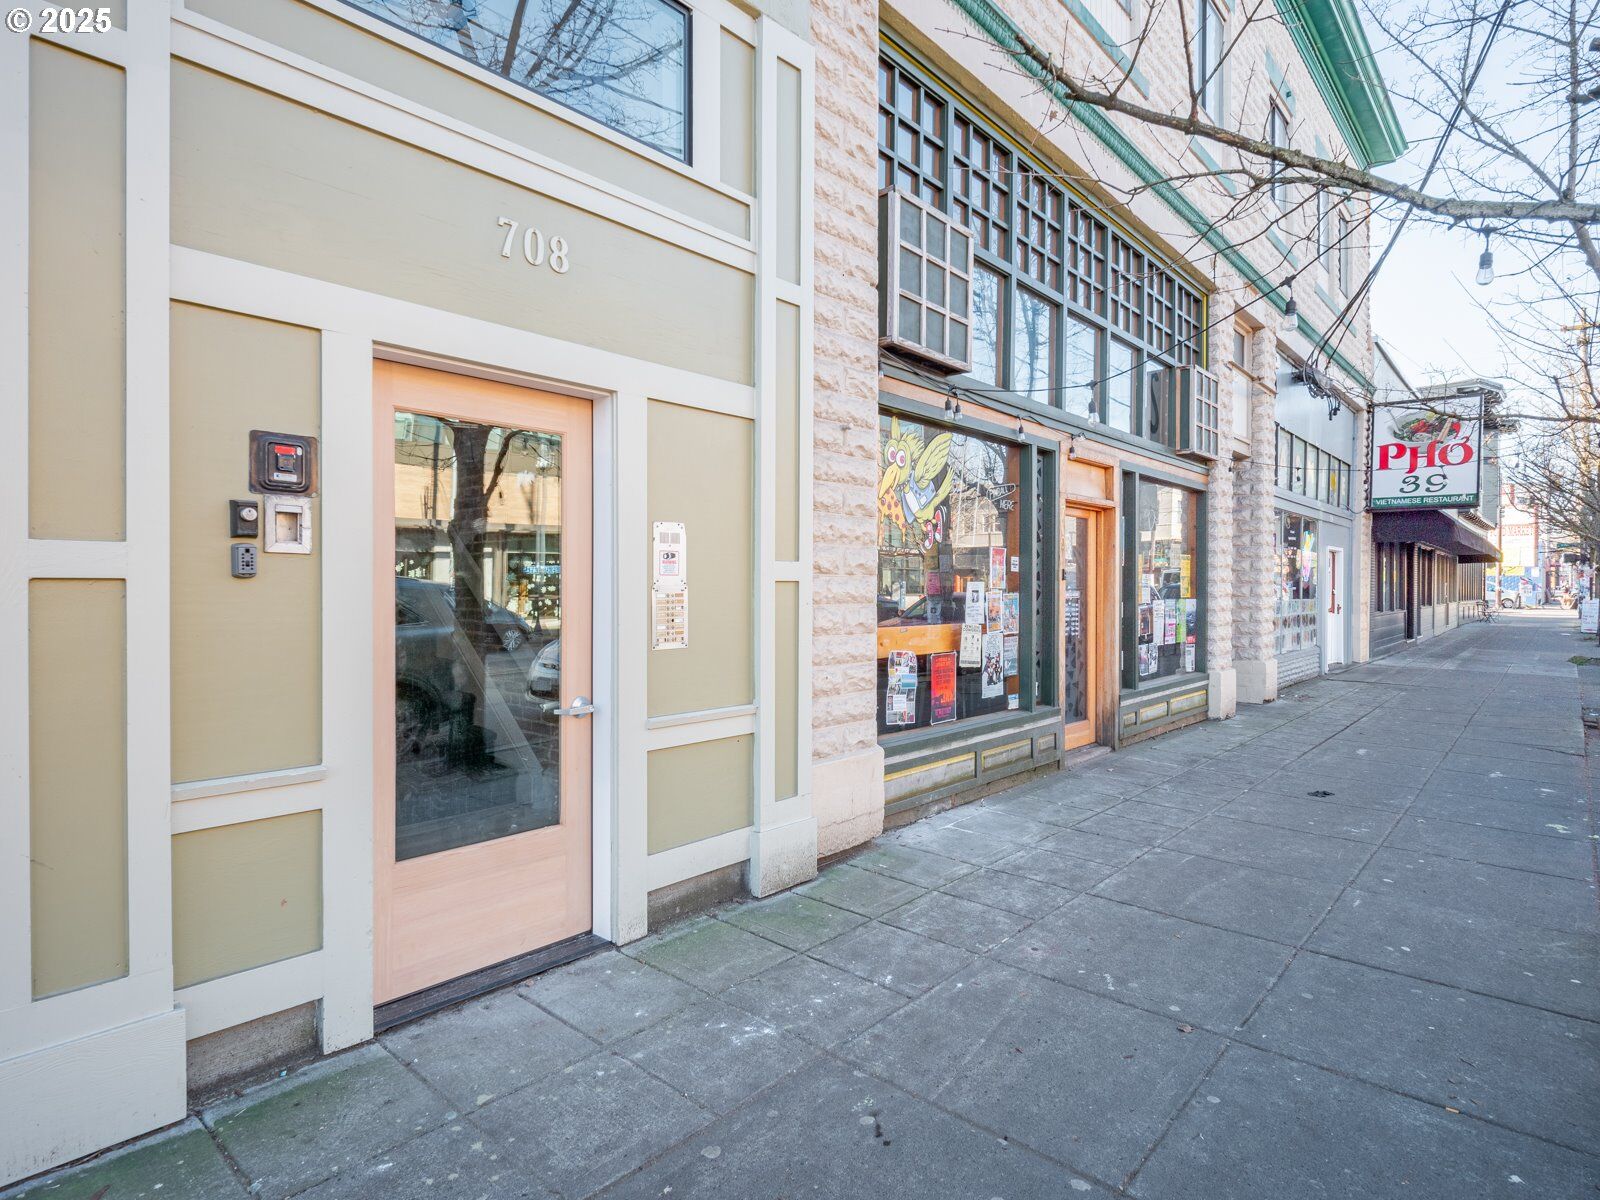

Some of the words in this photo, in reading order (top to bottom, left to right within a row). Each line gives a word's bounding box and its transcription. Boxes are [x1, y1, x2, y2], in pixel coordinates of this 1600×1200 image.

[497, 216, 569, 274] 708
[1399, 474, 1448, 493] 39
[1376, 497, 1422, 505] VIETNAMESE
[1423, 495, 1474, 503] RESTAURANT
